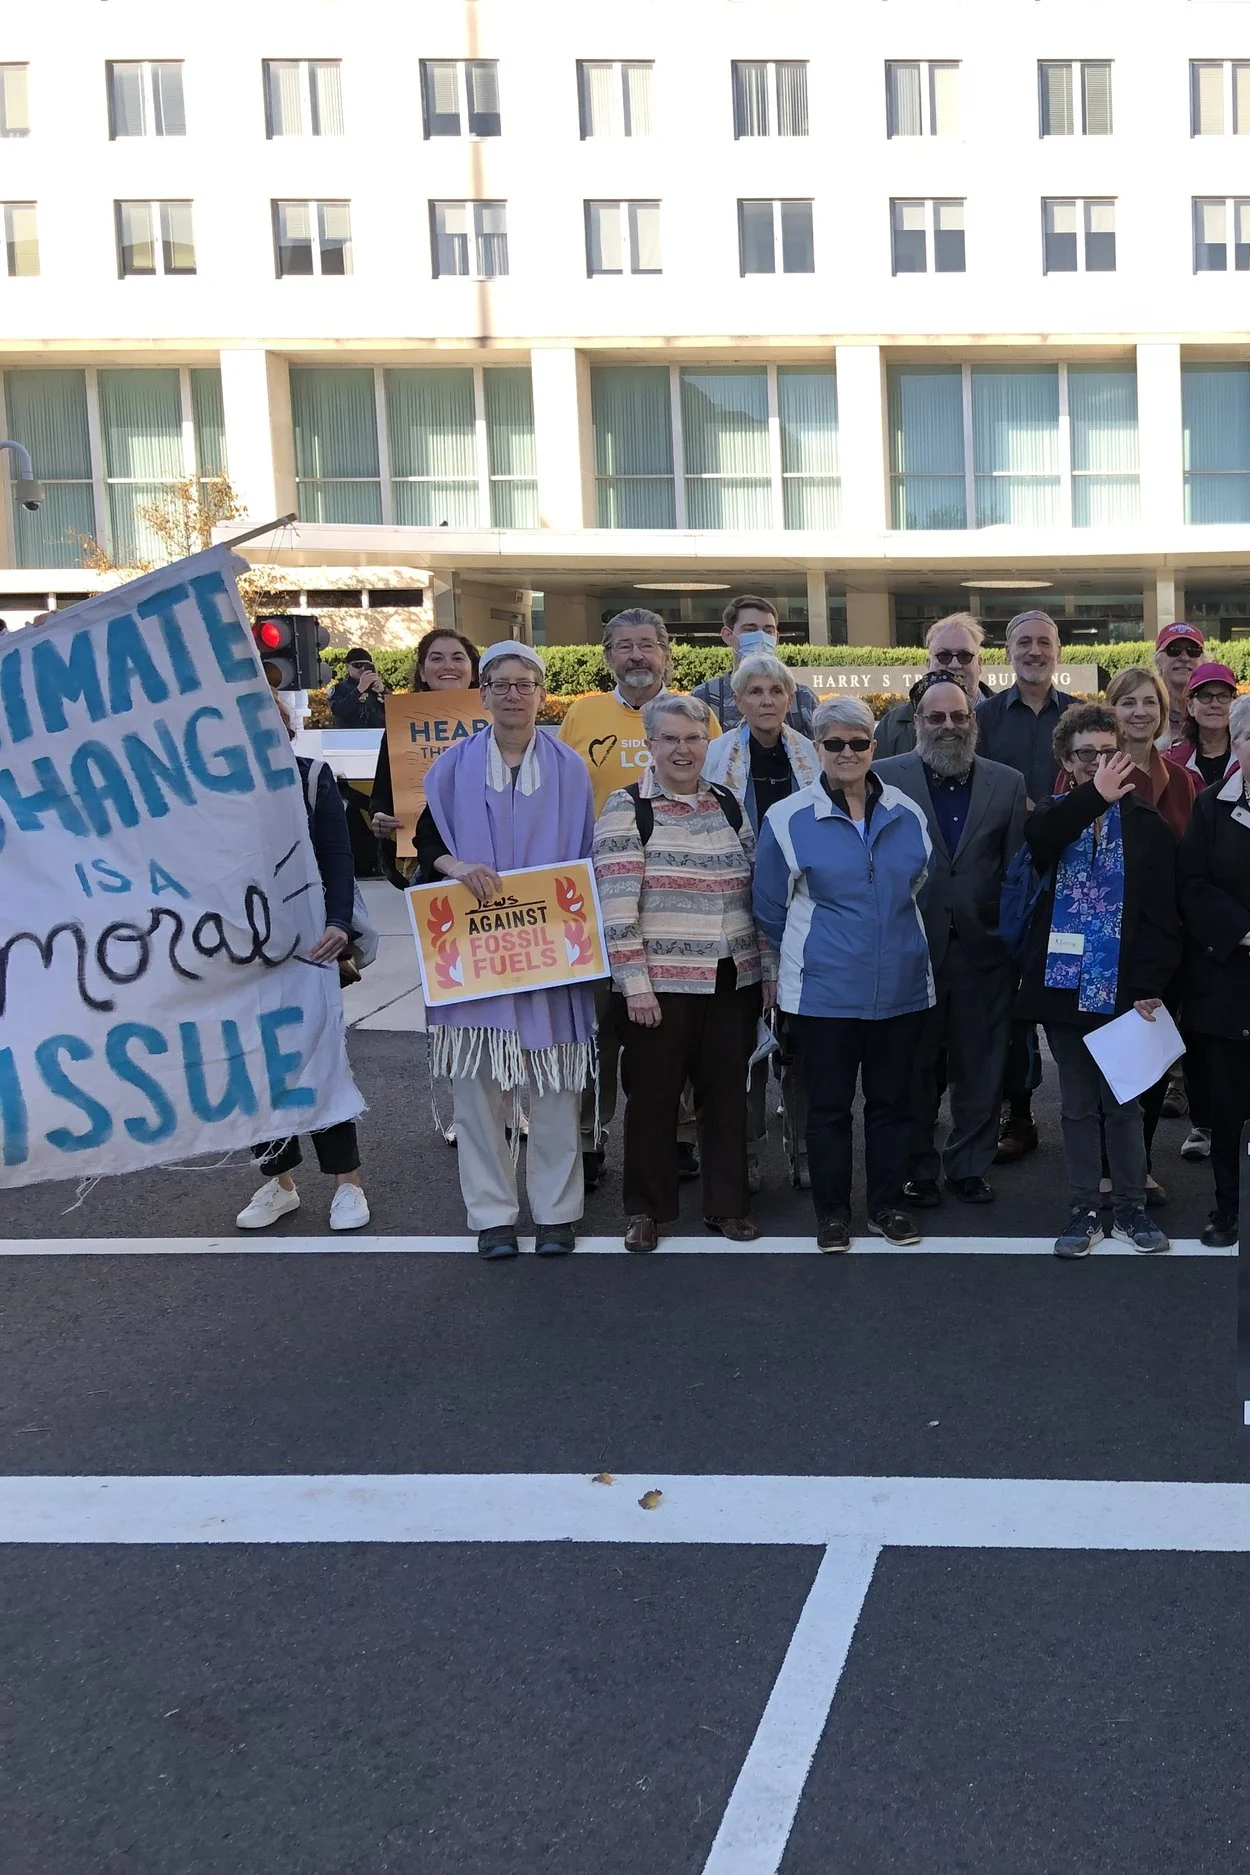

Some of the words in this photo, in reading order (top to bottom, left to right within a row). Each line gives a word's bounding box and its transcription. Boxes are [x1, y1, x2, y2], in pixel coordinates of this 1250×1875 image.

[0, 570, 258, 744] IMATE
[812, 674, 871, 688] HARRY
[882, 674, 890, 687] S
[988, 672, 1071, 686] BUING
[0, 691, 296, 853] HANGE
[74, 858, 132, 898] IS
[149, 858, 192, 900] A
[468, 906, 547, 935] AGAINST
[0, 884, 301, 1016] moral
[470, 927, 555, 958] FOSSIL
[473, 947, 557, 979] FUELS
[0, 1006, 319, 1167] ISSUE
